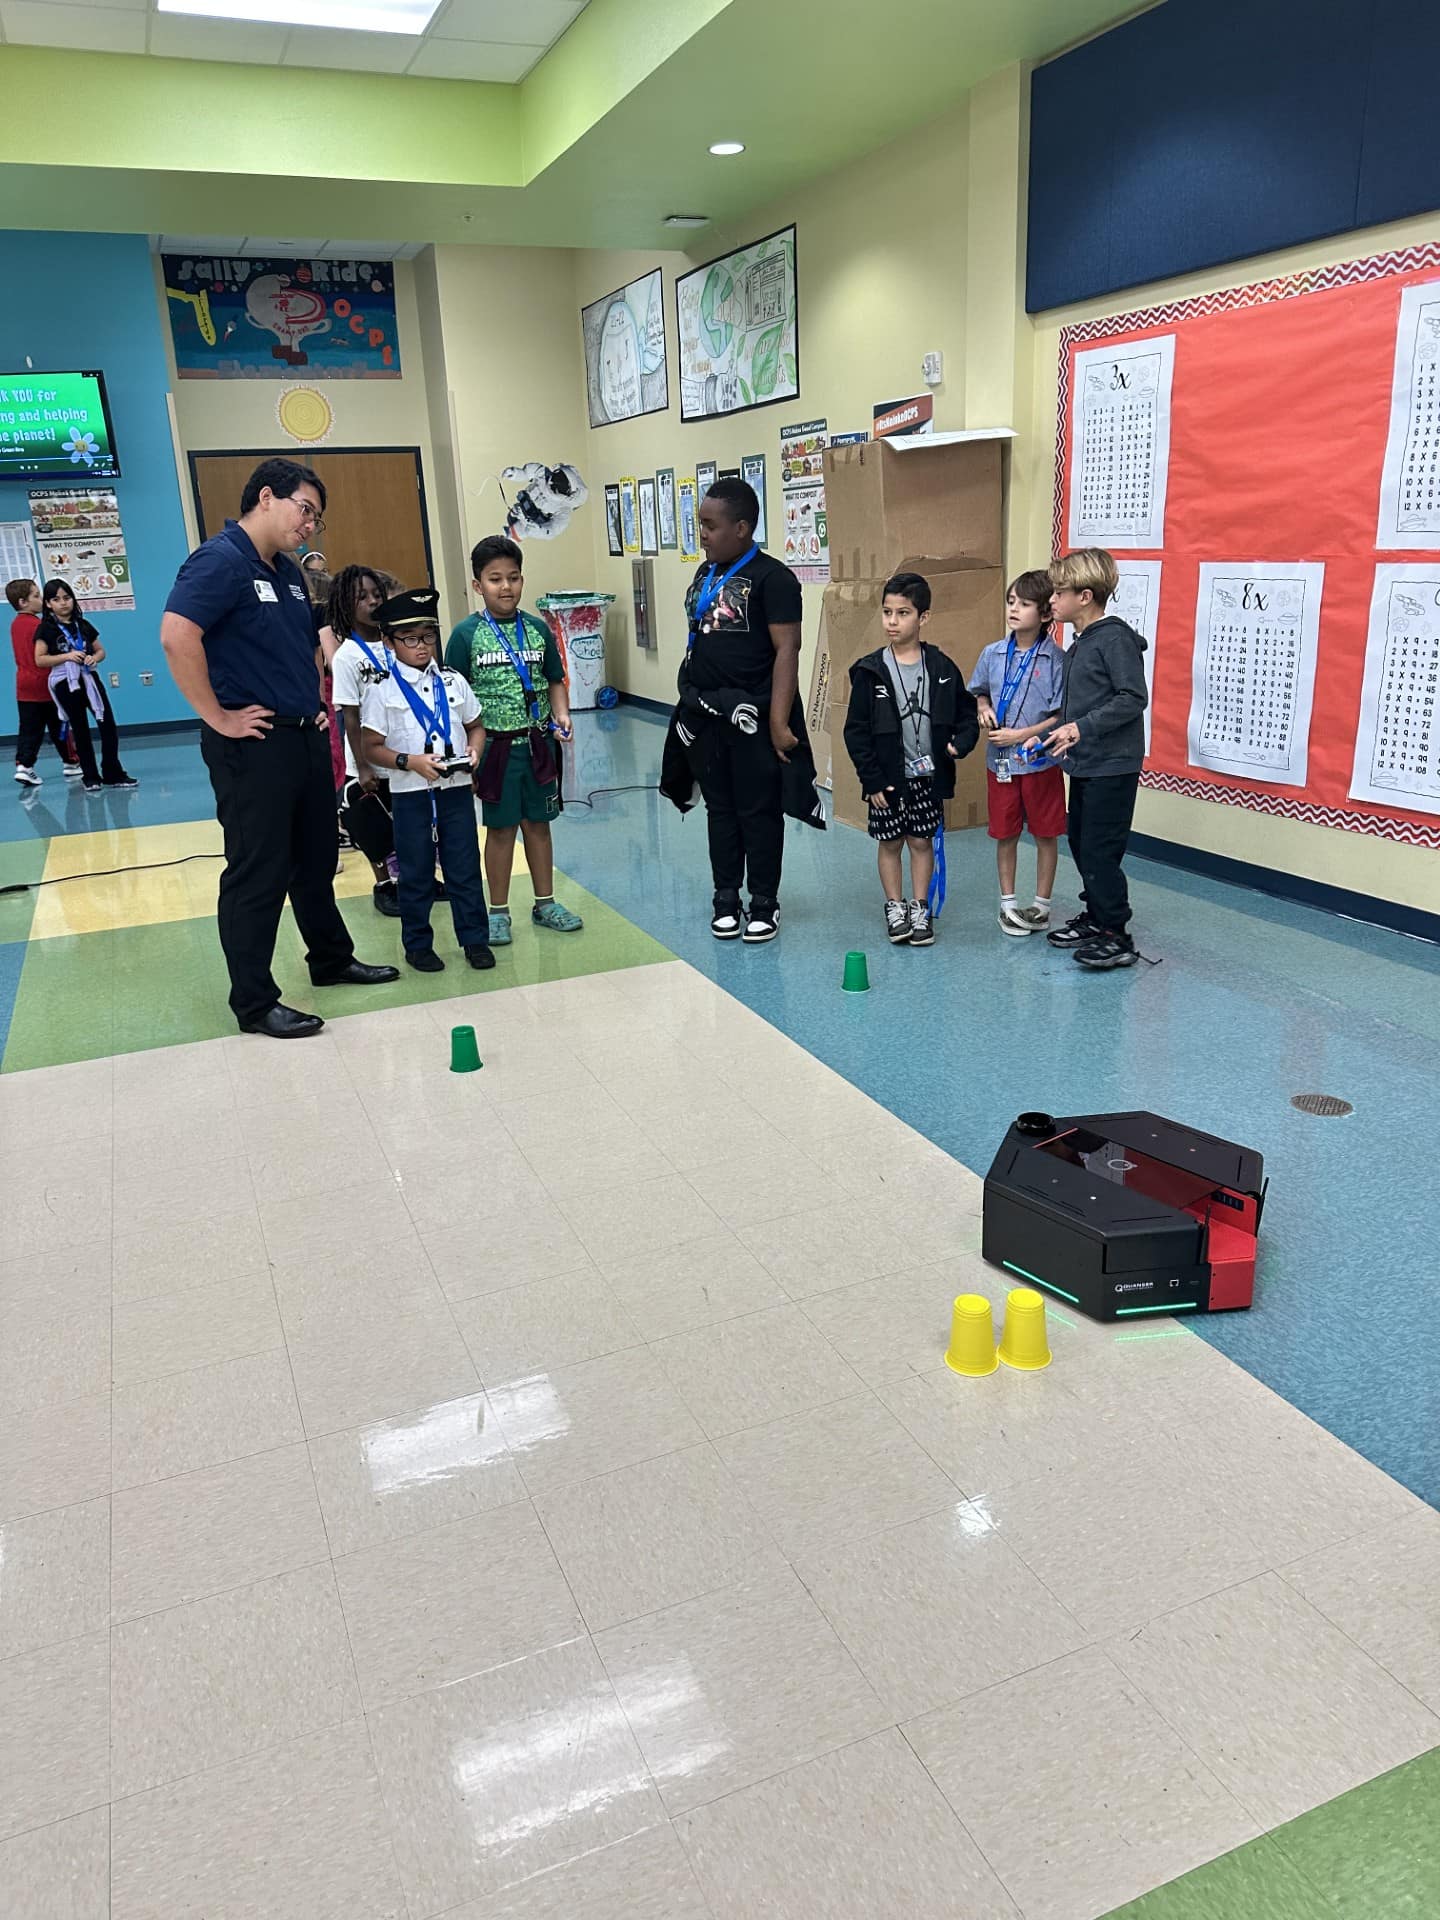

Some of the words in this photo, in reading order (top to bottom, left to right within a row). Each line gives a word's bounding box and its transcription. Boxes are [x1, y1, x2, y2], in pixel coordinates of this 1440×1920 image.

[177, 260, 250, 282] Sally
[310, 260, 373, 282] Ride
[1110, 364, 1132, 391] 3x
[12, 388, 33, 402] YOU
[37, 390, 57, 402] for
[19, 408, 40, 422] and
[43, 408, 88, 423] helping
[13, 427, 56, 444] planet!
[73, 540, 105, 548] COMPOST
[1242, 582, 1269, 611] 8x
